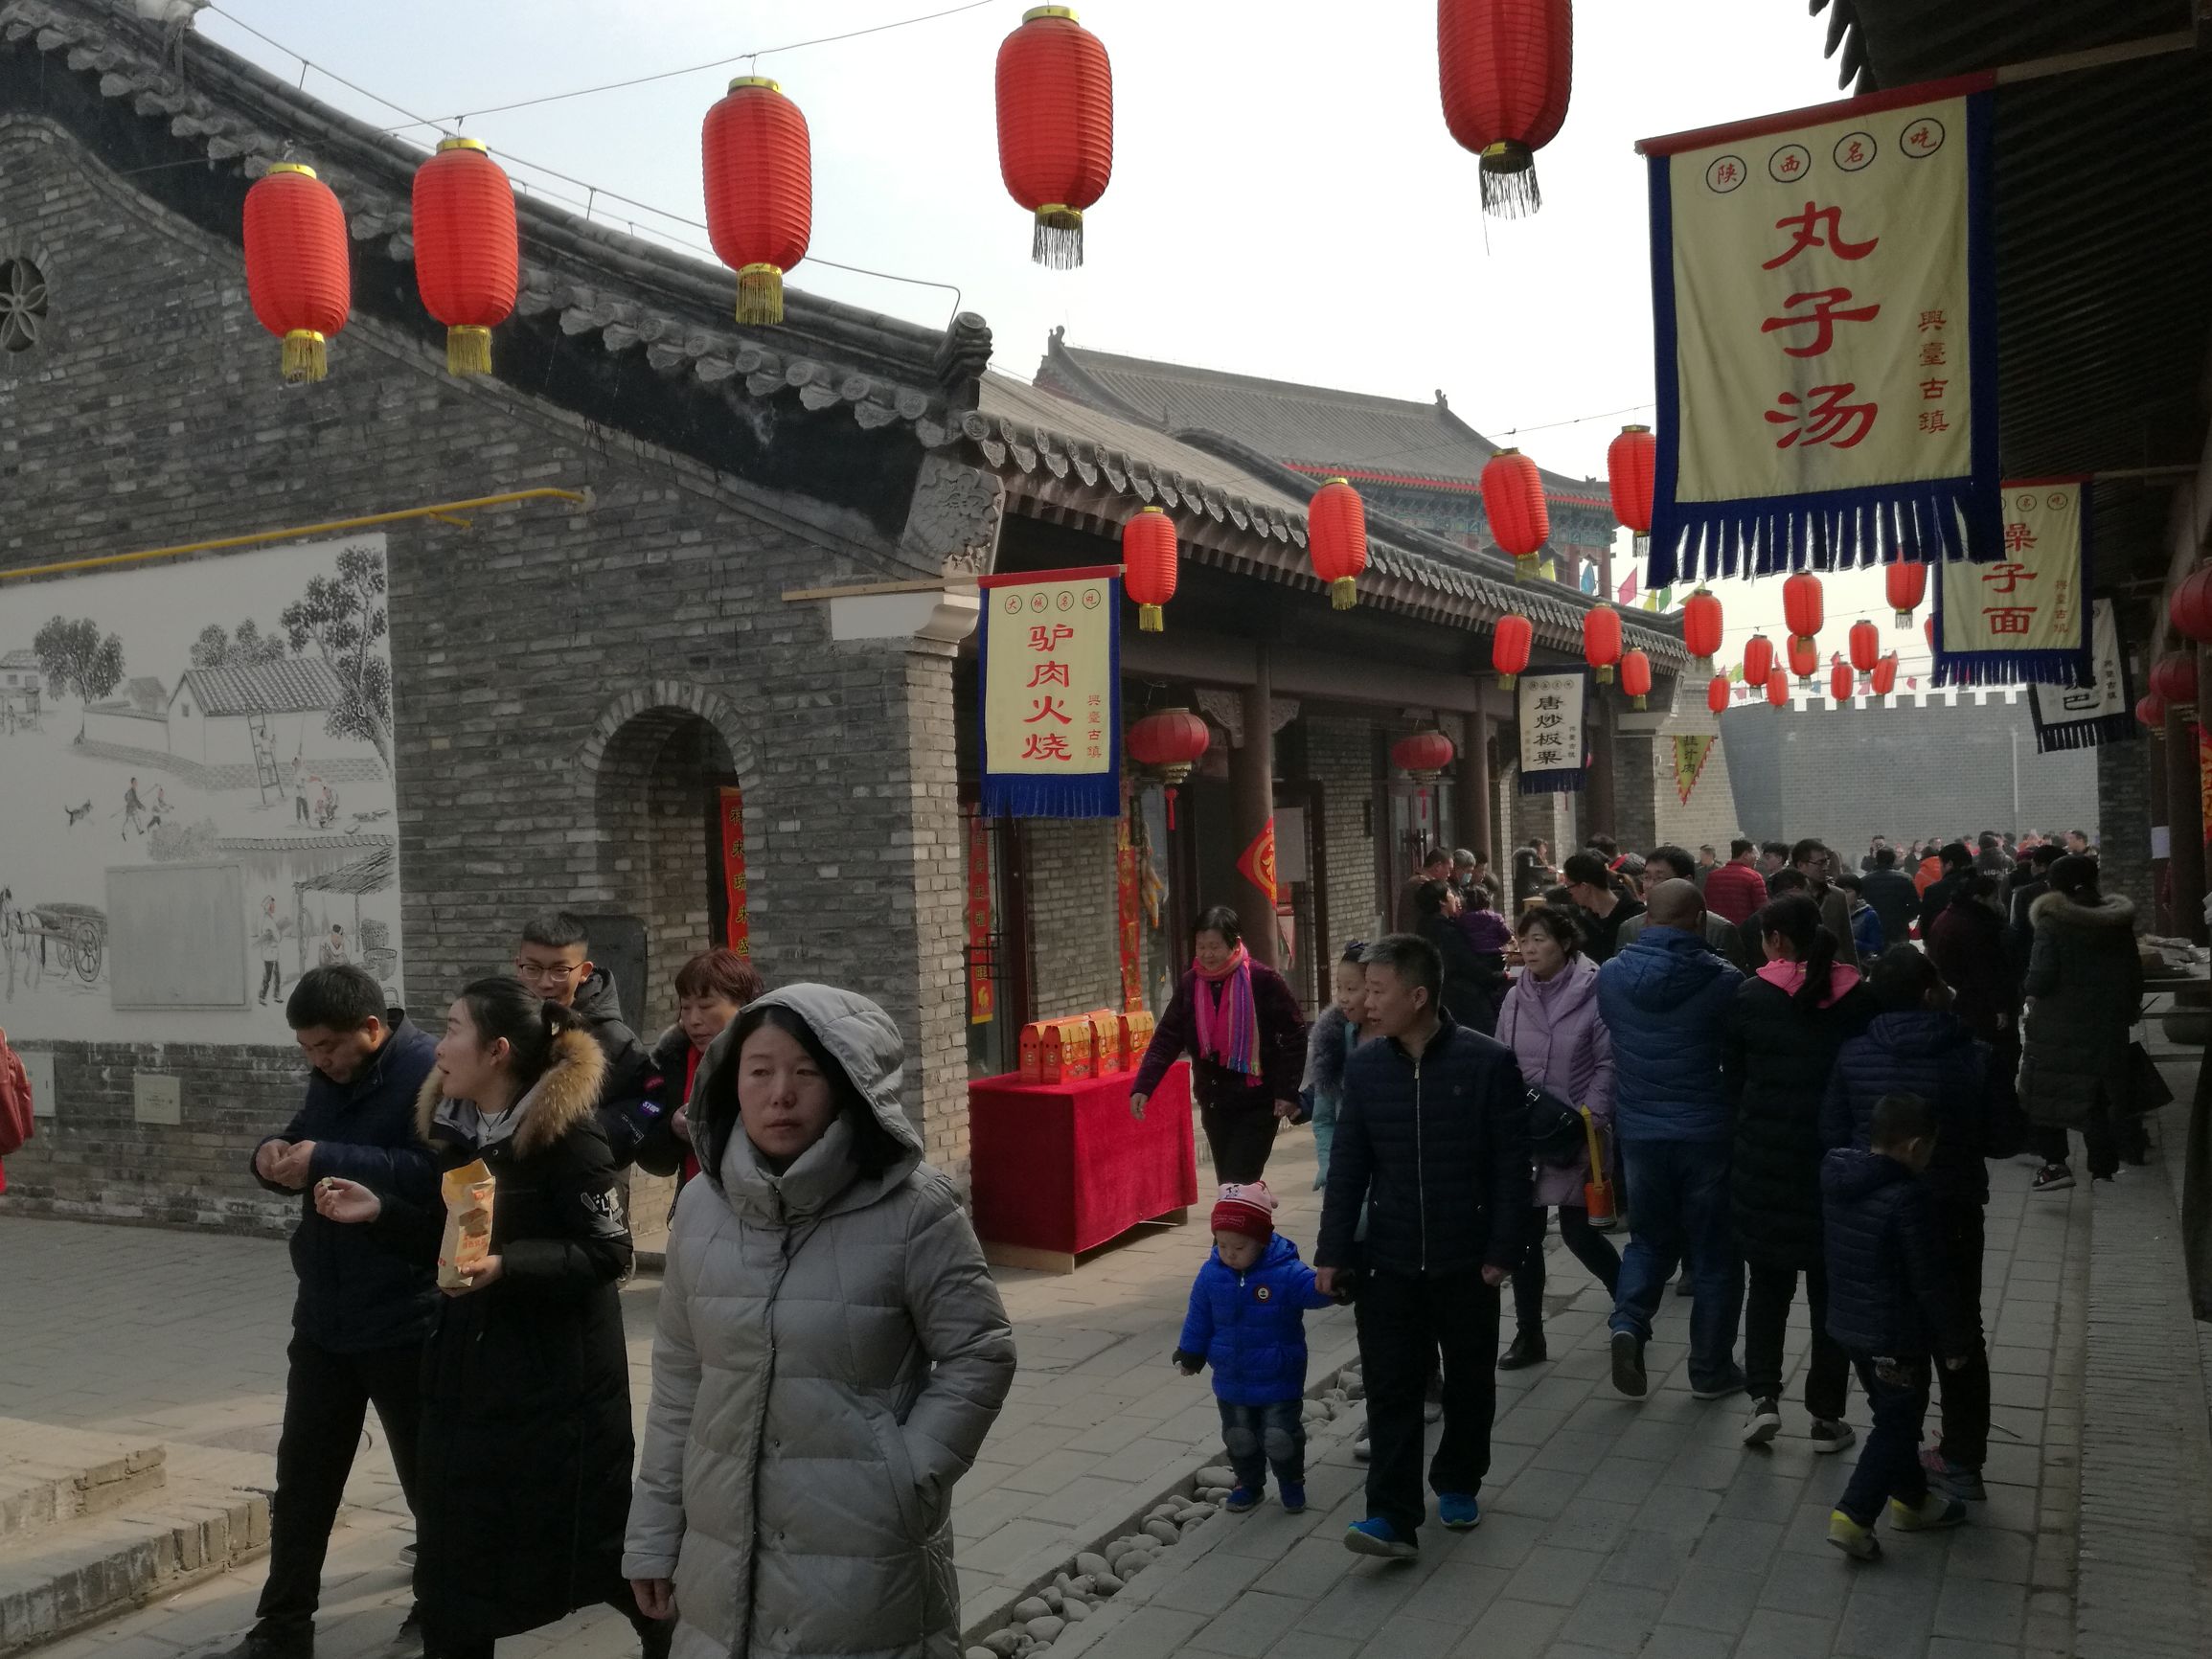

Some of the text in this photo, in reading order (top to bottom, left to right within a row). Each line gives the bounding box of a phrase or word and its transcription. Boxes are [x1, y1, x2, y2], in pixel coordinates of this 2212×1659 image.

[1716, 125, 1939, 186] 陕西名吃
[1761, 200, 1881, 449] 丸子汤
[1917, 308, 1950, 434] 興臺古鎮
[1020, 624, 1073, 761] 驴肉火烧
